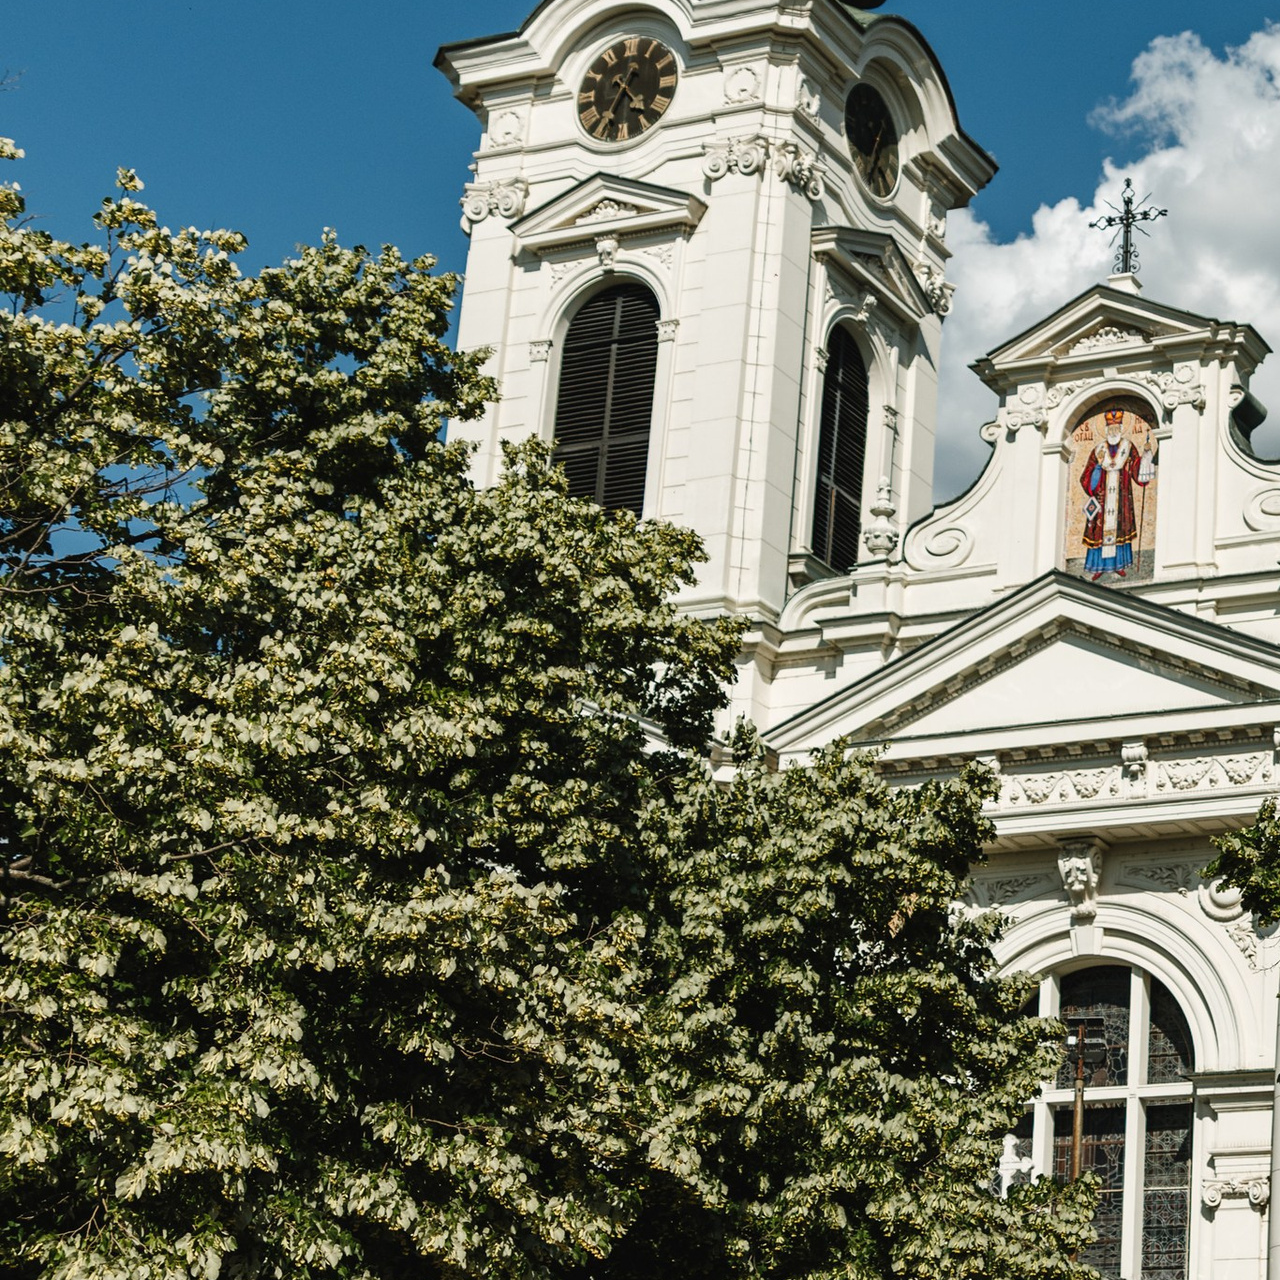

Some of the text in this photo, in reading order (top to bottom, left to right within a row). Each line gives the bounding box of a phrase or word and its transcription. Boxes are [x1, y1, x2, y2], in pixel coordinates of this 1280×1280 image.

[623, 38, 640, 57] XII
[644, 40, 658, 58] I
[659, 74, 676, 89] III
